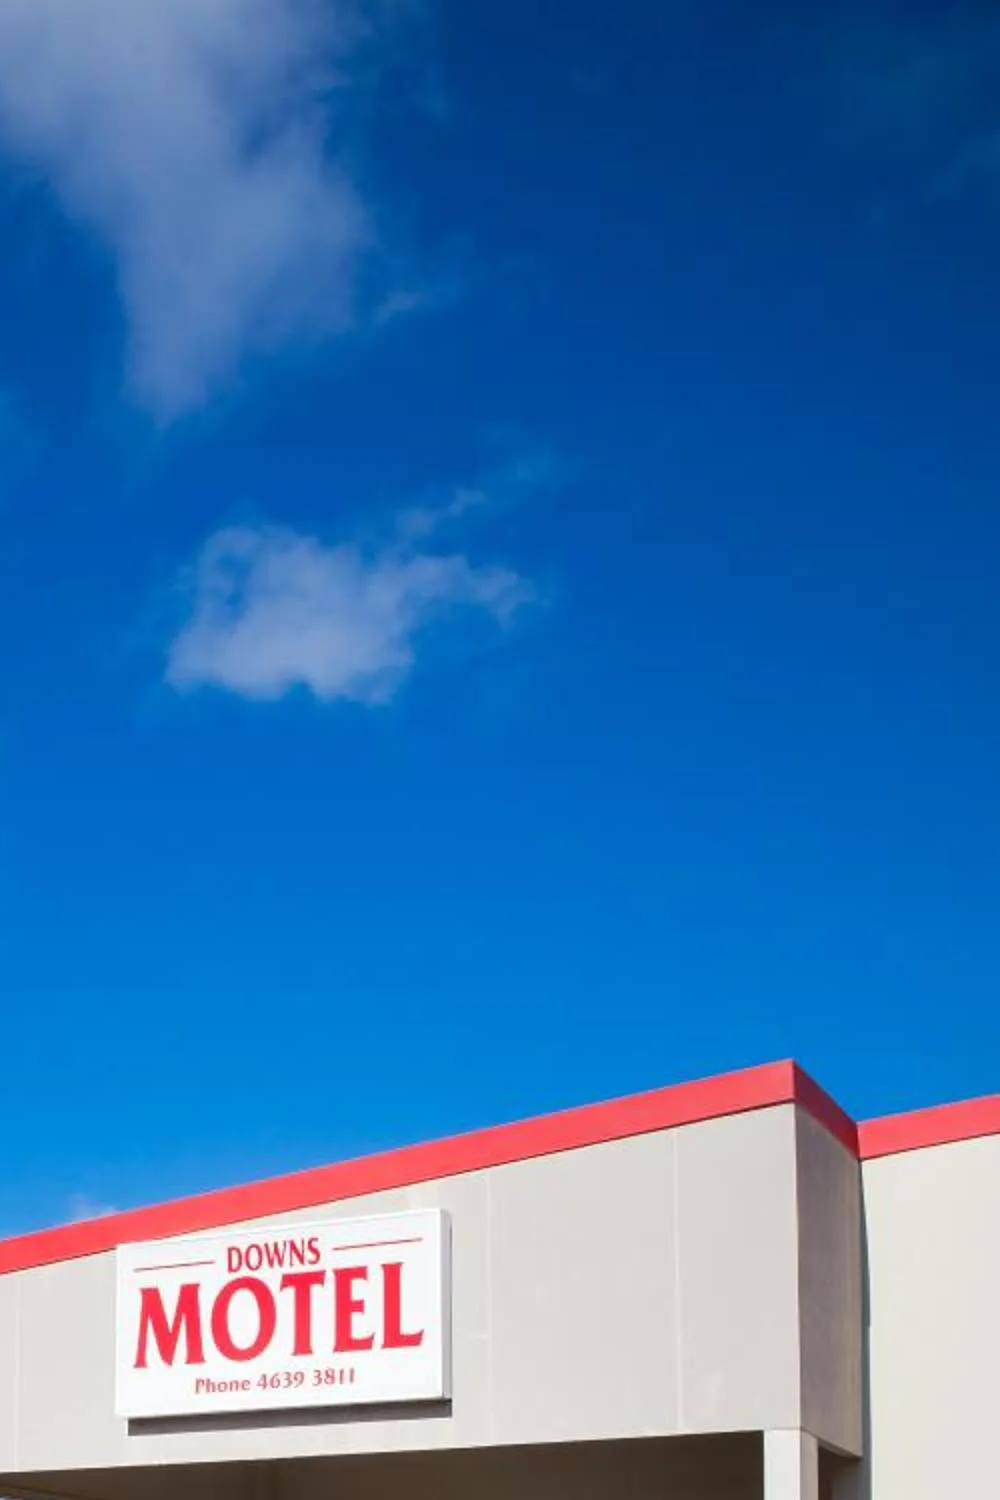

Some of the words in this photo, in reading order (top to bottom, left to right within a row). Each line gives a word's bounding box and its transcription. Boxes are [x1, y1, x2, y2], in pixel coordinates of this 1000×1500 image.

[226, 1237, 322, 1274] DOWNS
[132, 1262, 425, 1369] MOTEL
[194, 1376, 251, 1394] Phone
[256, 1371, 305, 1392] 4639
[312, 1367, 356, 1386] 3811
